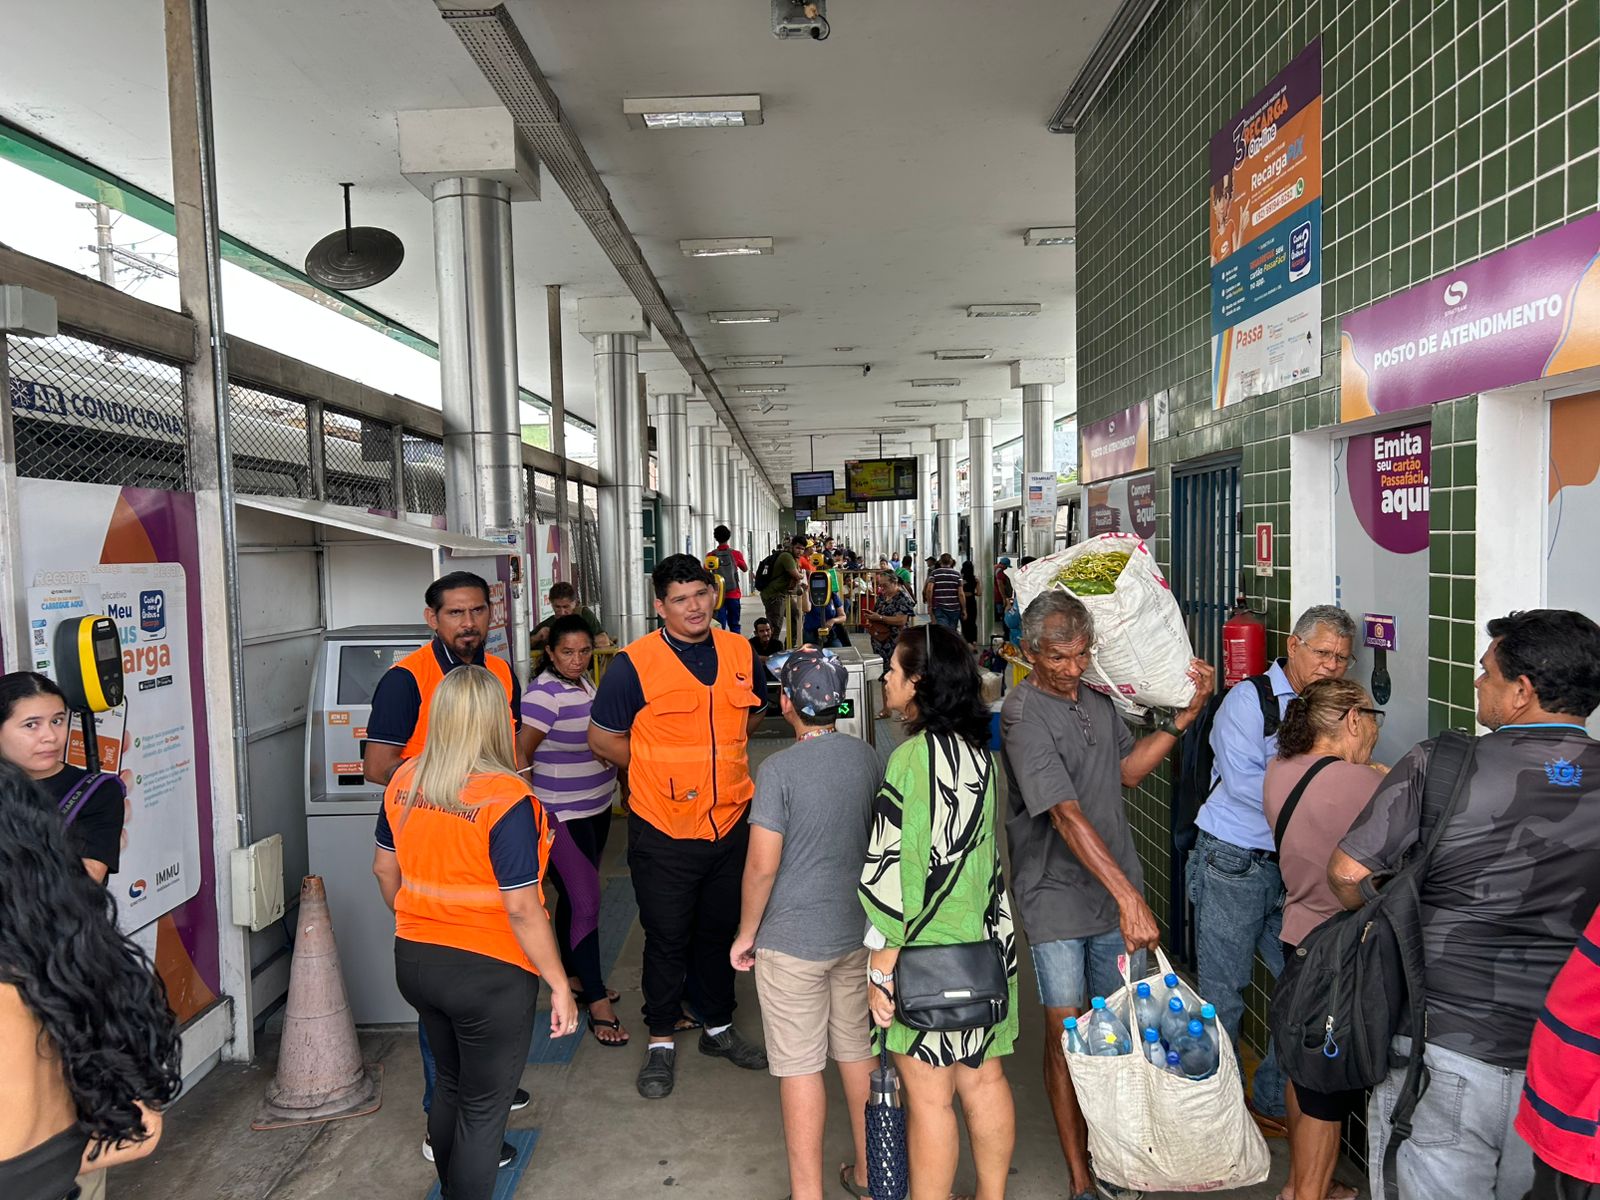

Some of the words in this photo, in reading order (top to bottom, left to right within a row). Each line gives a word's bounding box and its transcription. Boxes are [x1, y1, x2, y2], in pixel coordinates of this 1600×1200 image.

[1236, 323, 1264, 350] Passa
[1374, 341, 1416, 371] POSTO
[1418, 333, 1438, 358] DE
[1440, 293, 1563, 350] ATENDIMENTO
[71, 392, 185, 437] CONDICIONA
[1374, 431, 1422, 460] Emita
[1376, 460, 1392, 472] seu
[1392, 456, 1421, 473] cartão
[1381, 475, 1430, 520] aqui
[108, 603, 132, 619] Meu
[155, 861, 180, 886] IMMU
